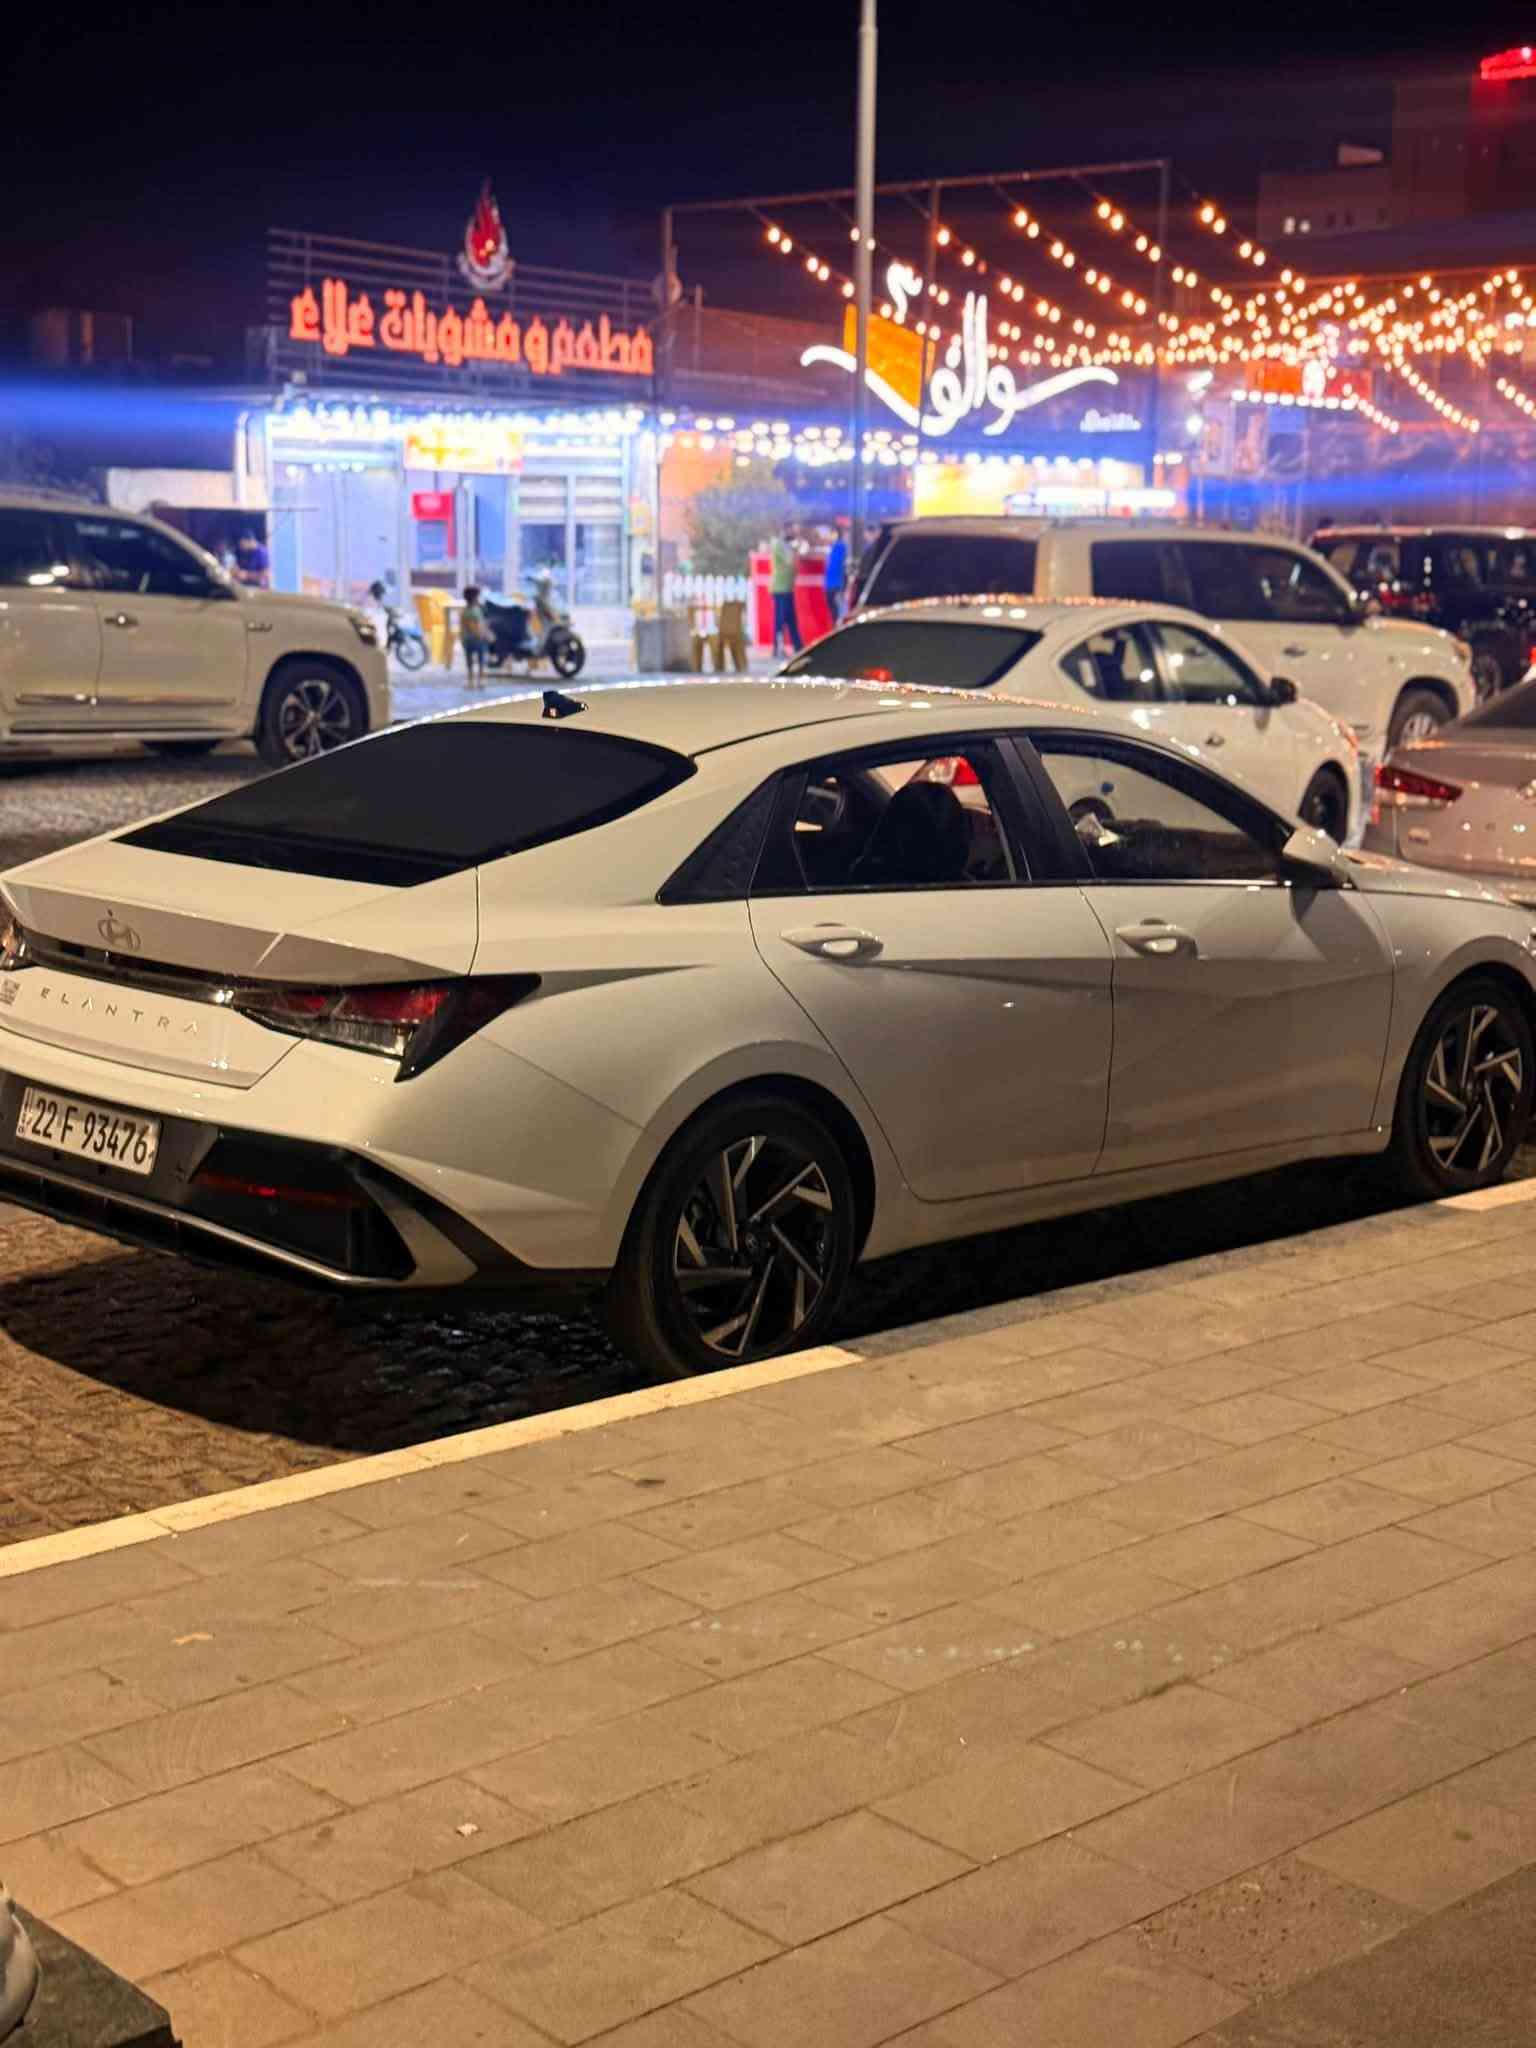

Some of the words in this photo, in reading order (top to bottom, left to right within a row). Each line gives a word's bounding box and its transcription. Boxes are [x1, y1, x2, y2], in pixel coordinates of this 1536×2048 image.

[380, 289, 521, 366] مشويات
[524, 314, 551, 375] و
[550, 312, 654, 375] مطعم
[40, 987, 200, 1034] ELANTRA
[32, 1098, 58, 1139] 22
[61, 1106, 78, 1144] F
[82, 1111, 150, 1165] 93476
